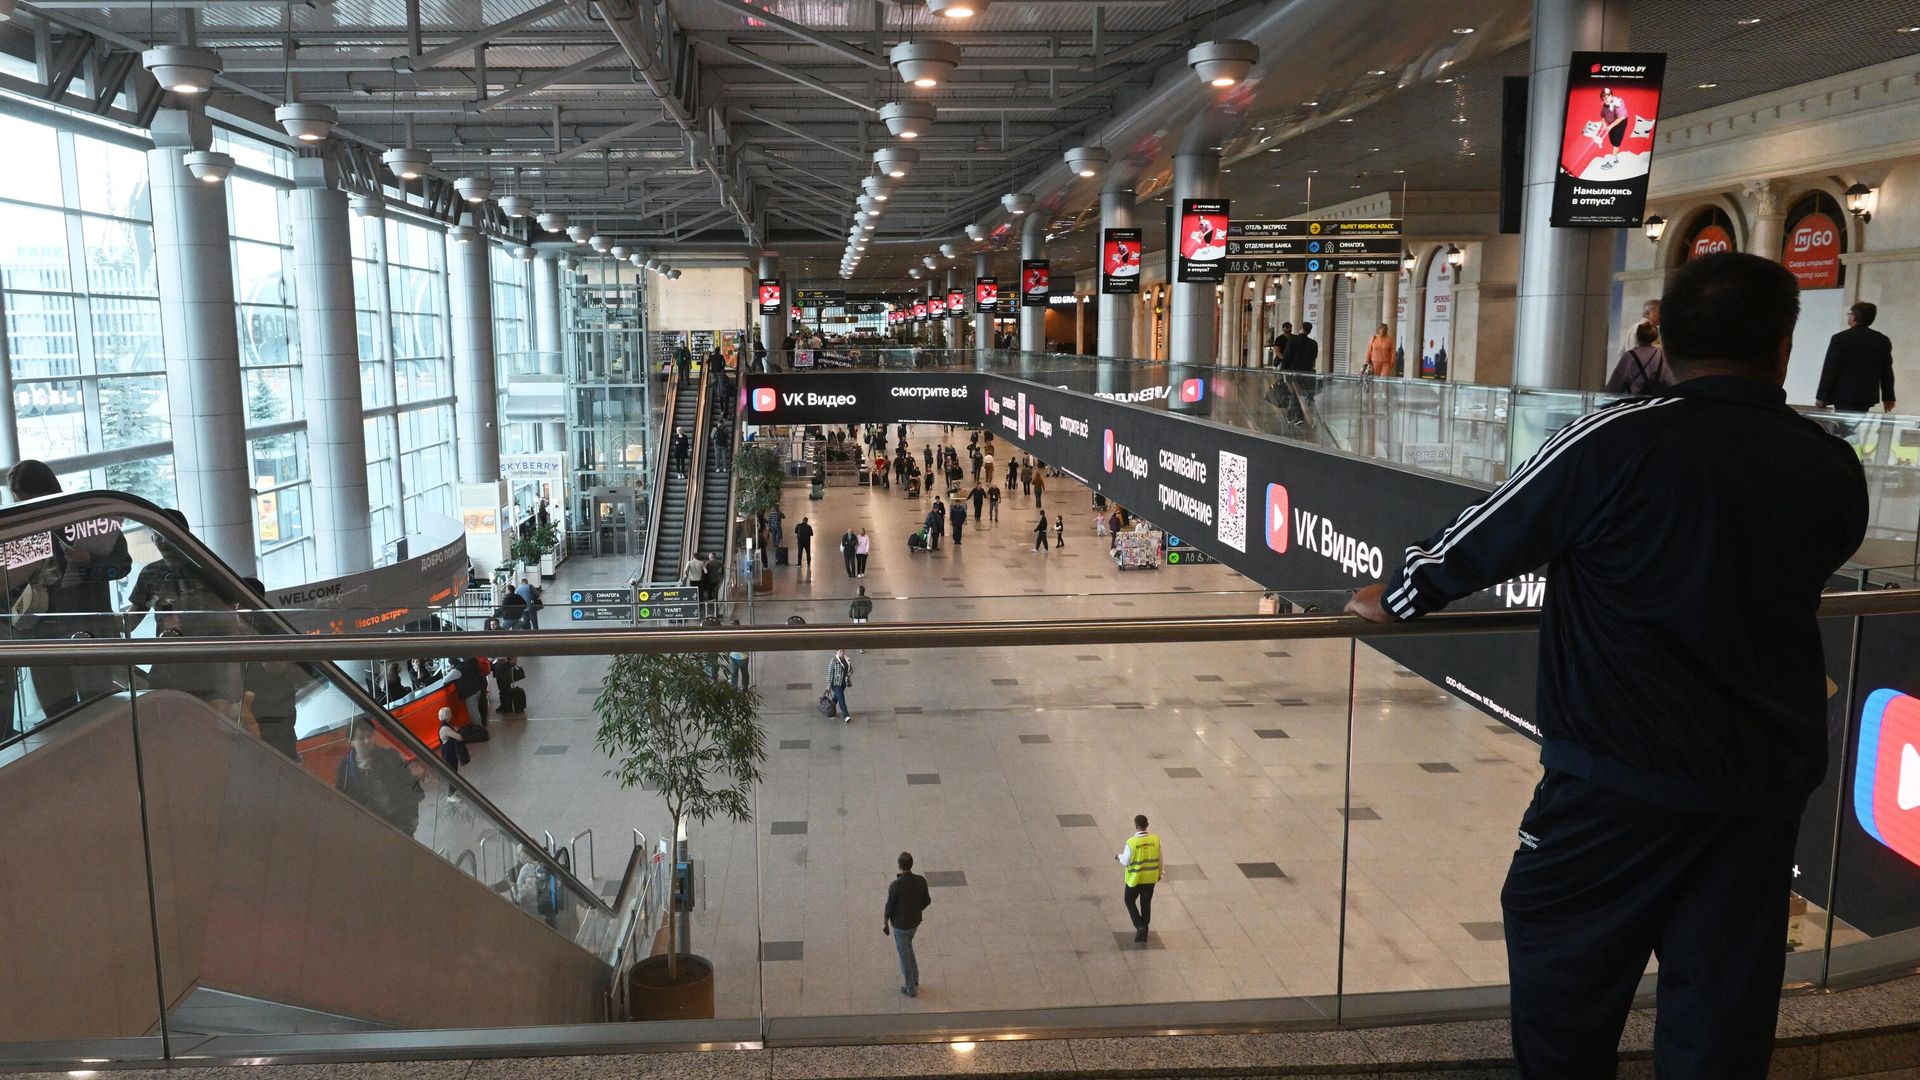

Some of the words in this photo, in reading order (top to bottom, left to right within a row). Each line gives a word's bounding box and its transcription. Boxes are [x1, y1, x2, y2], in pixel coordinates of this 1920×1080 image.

[1573, 186, 1632, 195] Намылились
[1580, 196, 1615, 206] отпуск?
[782, 393, 805, 406] VK
[807, 392, 856, 407] Видео
[891, 387, 950, 399] смотрите
[951, 386, 968, 398] всё
[500, 462, 559, 471] SKYBERRY
[1115, 442, 1125, 469] VK
[1125, 446, 1148, 480] Видео
[1159, 448, 1207, 484] скачивайте
[1159, 483, 1213, 526] приложение
[1294, 507, 1318, 553] VK
[1321, 517, 1383, 579] Видео
[279, 583, 342, 606] WELCOME
[356, 616, 380, 628] Место
[1446, 676, 1457, 687] ООО
